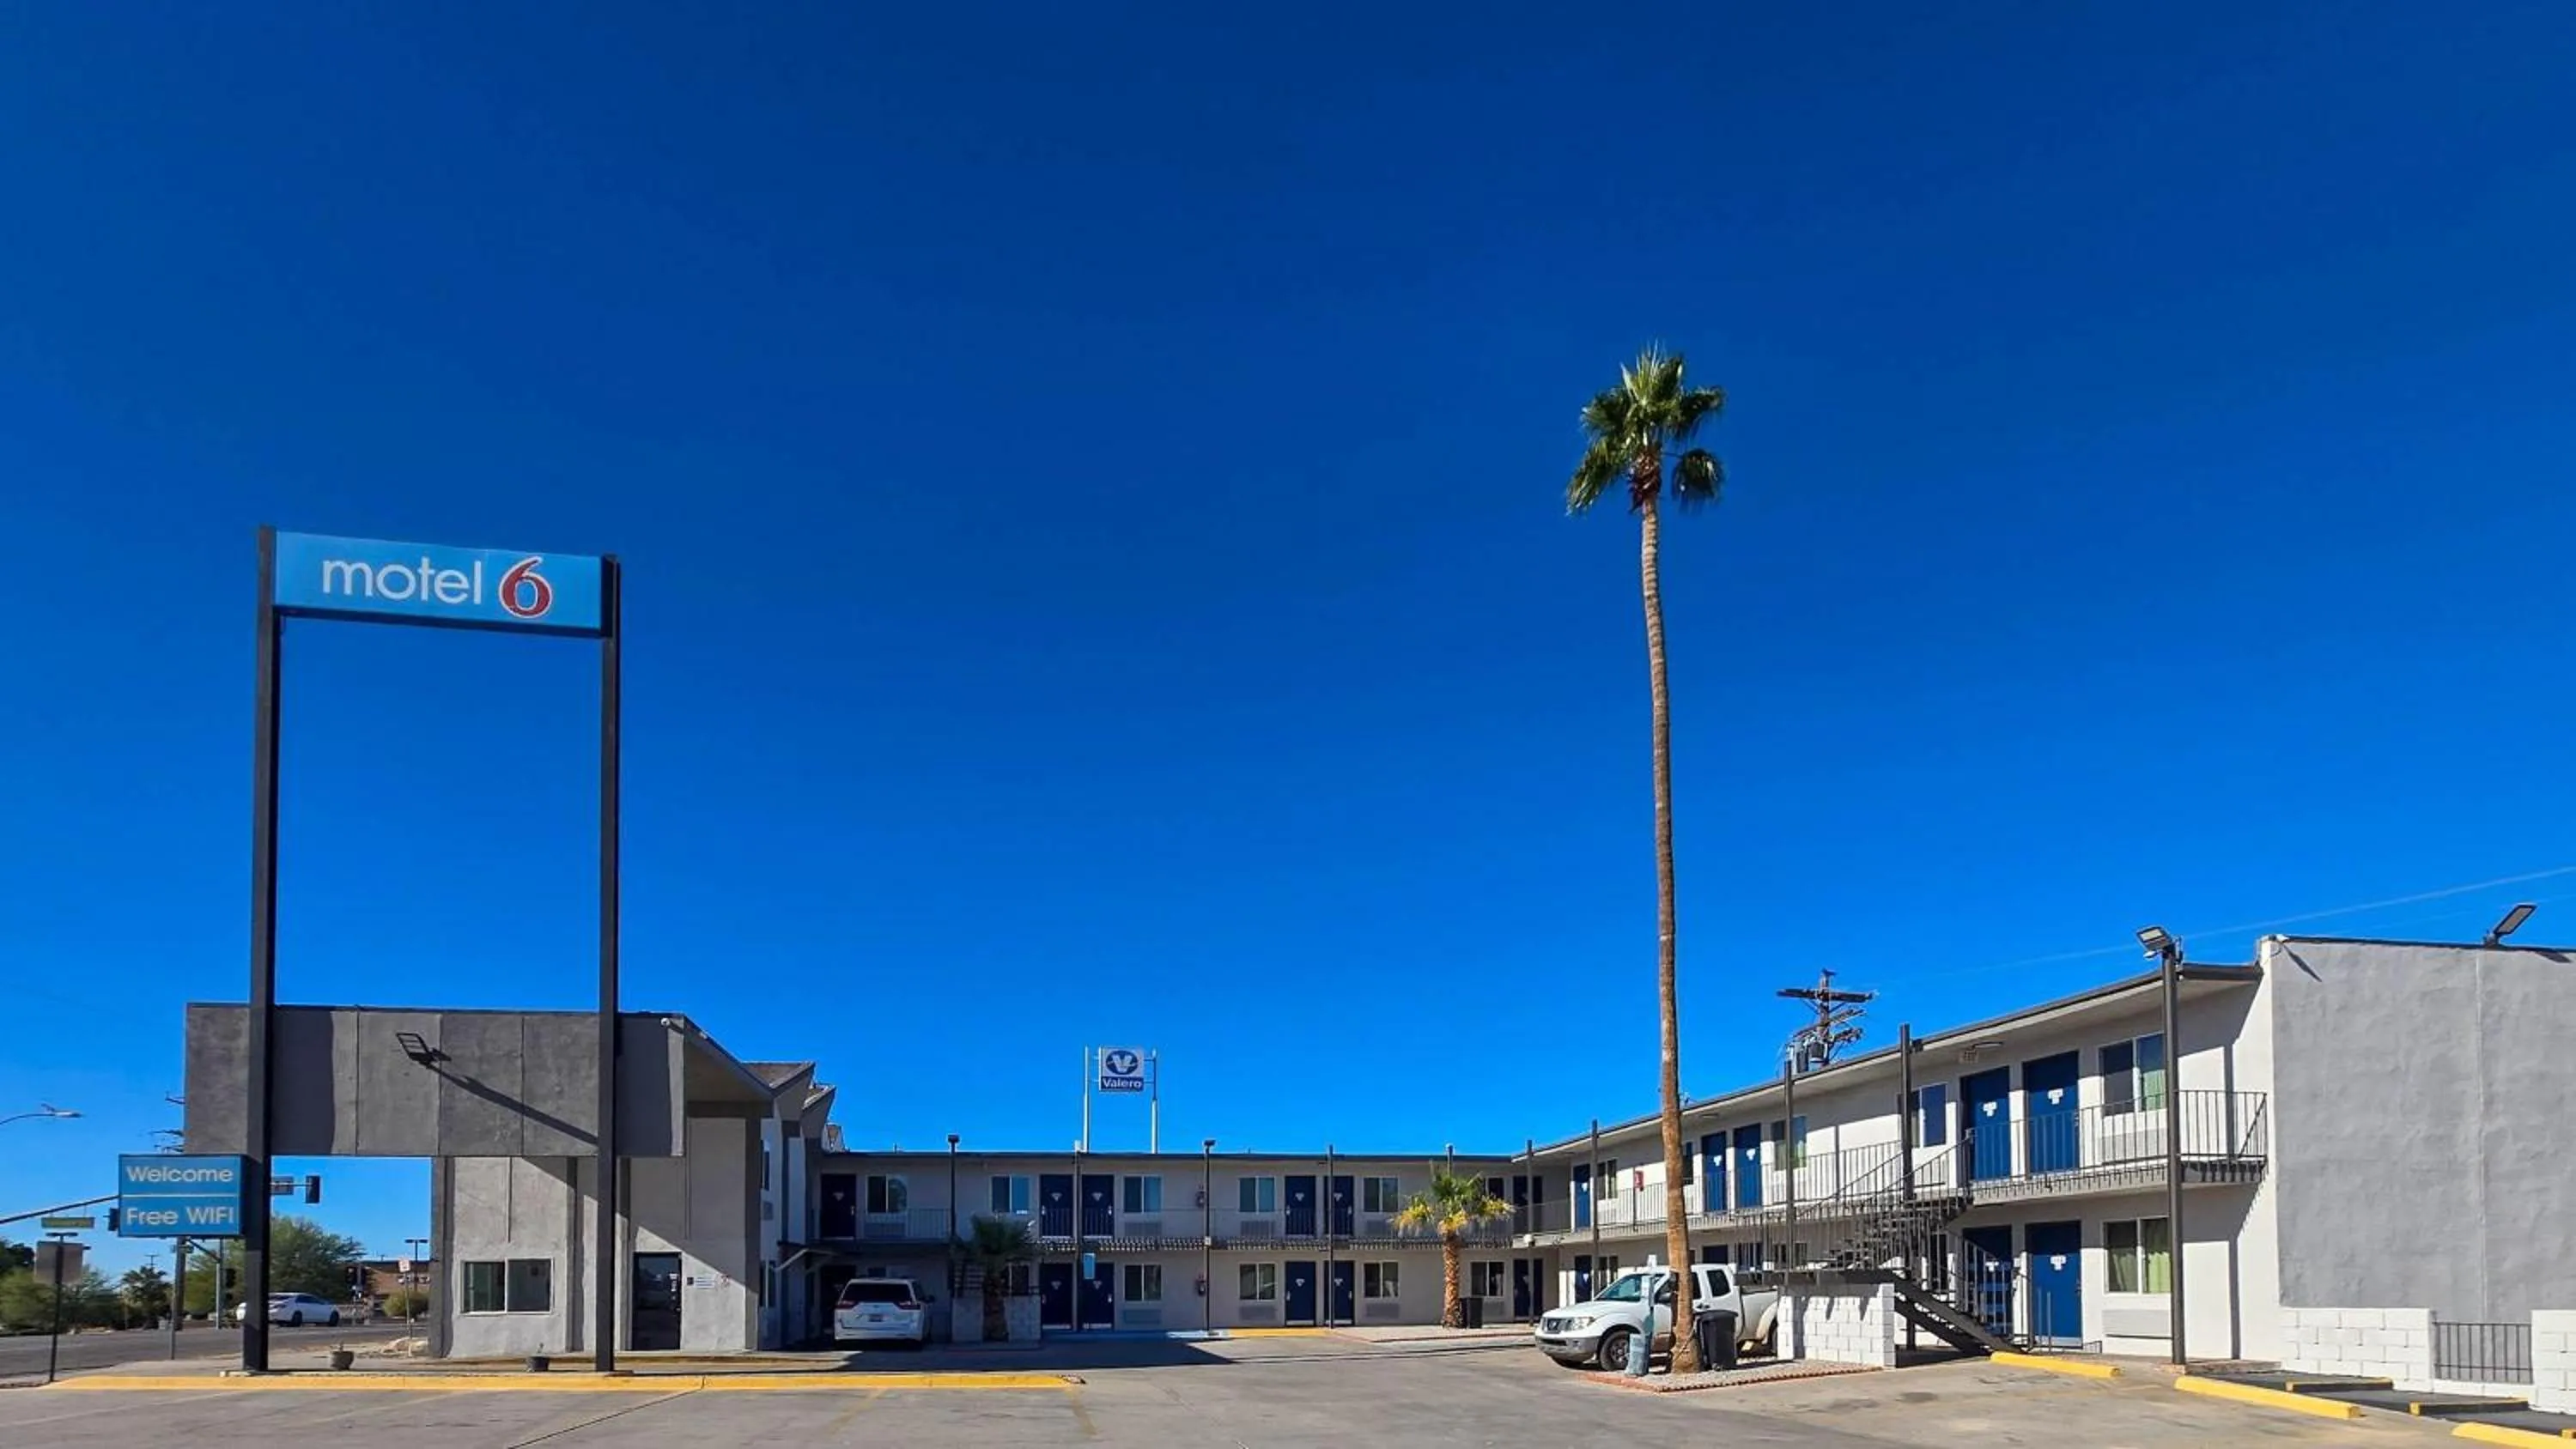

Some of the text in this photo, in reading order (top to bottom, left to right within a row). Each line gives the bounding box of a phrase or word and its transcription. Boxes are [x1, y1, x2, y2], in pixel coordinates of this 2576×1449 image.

[322, 555, 553, 619] motel 6
[1102, 1077, 1142, 1088] Valero
[126, 1165, 234, 1182] Welcome
[126, 1206, 234, 1226] Free WIFI
